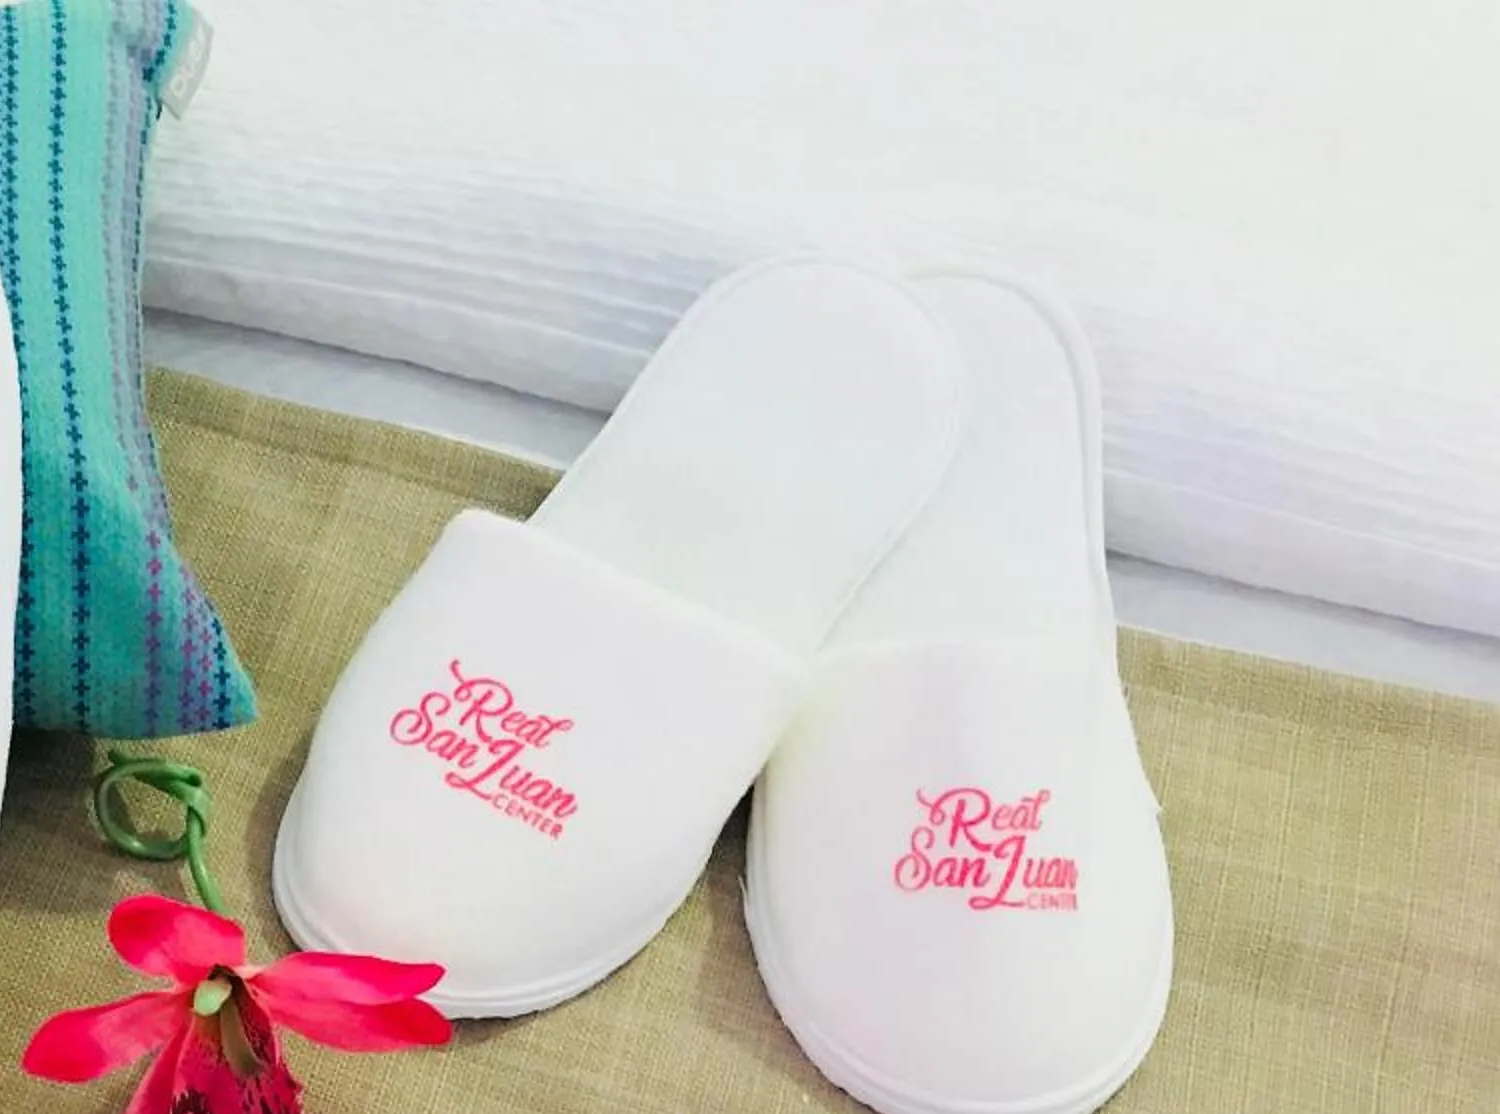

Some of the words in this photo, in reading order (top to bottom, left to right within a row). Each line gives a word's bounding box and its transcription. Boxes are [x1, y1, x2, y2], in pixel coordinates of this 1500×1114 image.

[390, 691, 479, 769] San
[492, 793, 564, 840] CENTER
[895, 826, 990, 891] San
